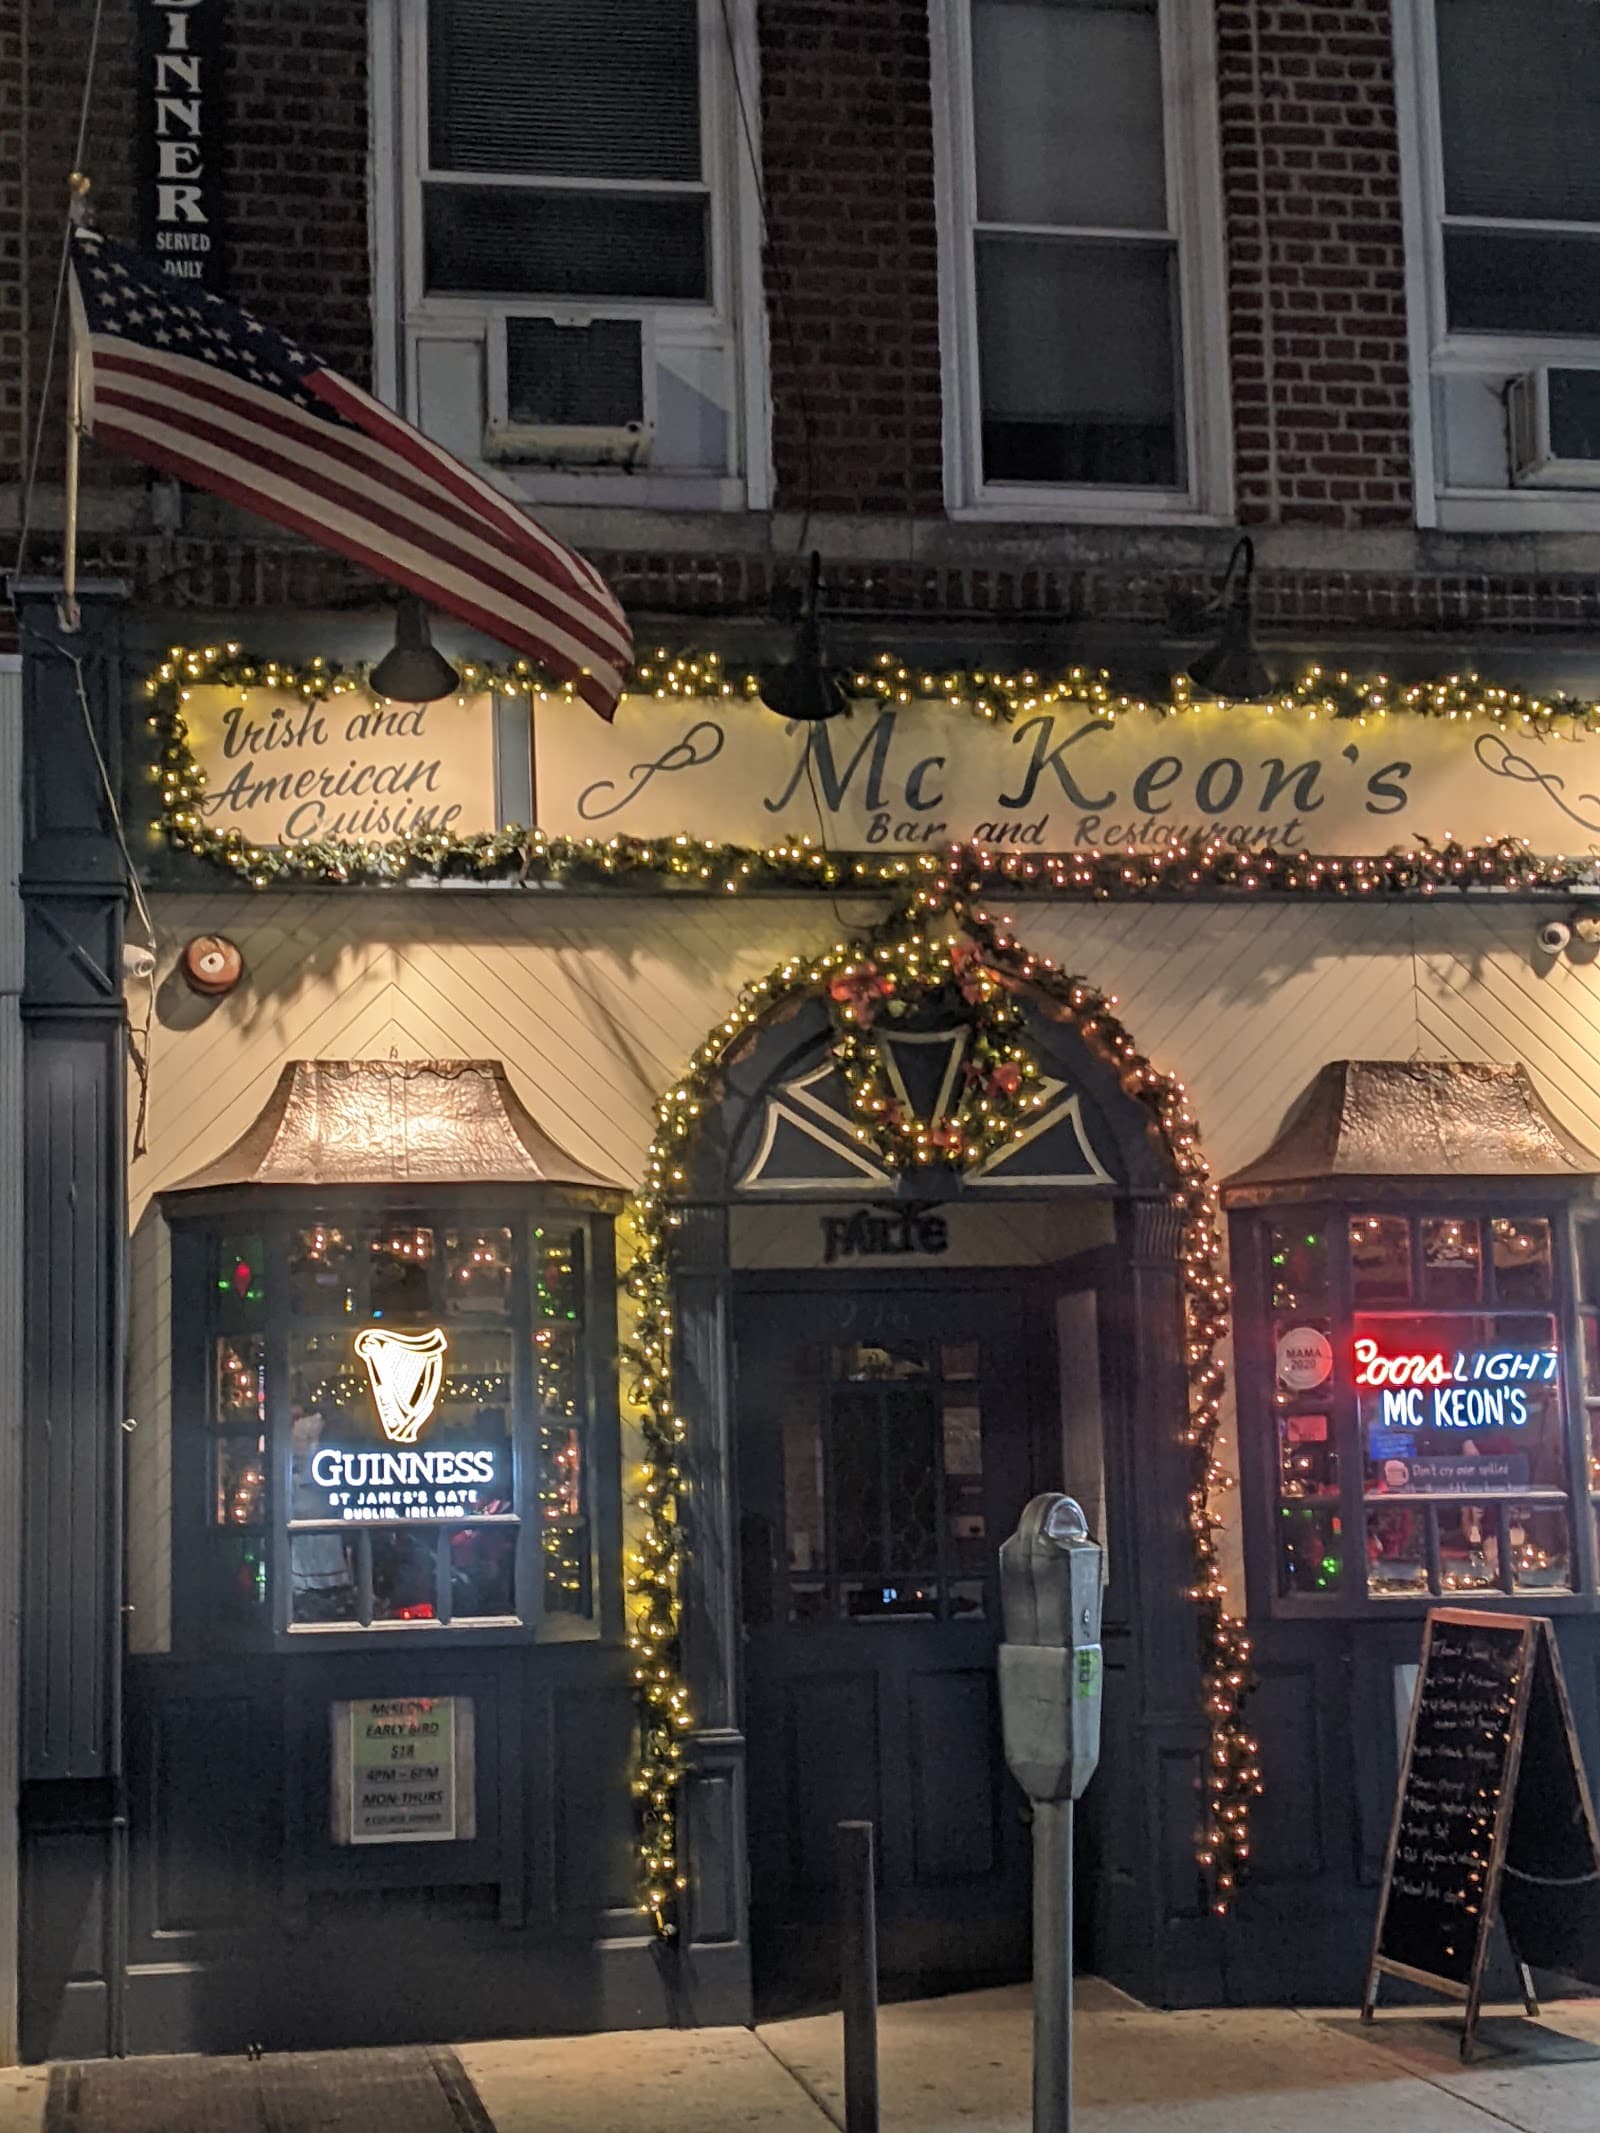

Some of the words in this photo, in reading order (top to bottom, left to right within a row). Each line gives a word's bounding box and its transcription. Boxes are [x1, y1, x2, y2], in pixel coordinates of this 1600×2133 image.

[154, 0, 208, 222] INNER
[156, 231, 211, 251] SERVED
[163, 259, 204, 280] DAILY
[222, 700, 329, 759] Irish
[345, 703, 426, 741] and
[201, 759, 442, 817] American
[284, 797, 463, 841] Cuisine
[866, 813, 947, 844] Bar
[974, 814, 1050, 846] and
[1073, 815, 1306, 848] Restaurant
[1285, 1347, 1322, 1359] MAMA
[1354, 1338, 1453, 1386] Coors
[1453, 1352, 1558, 1381] LIGHT
[1383, 1387, 1424, 1427] MC
[1433, 1386, 1528, 1428] KEON'S
[311, 1448, 495, 1487] GUINNESS
[356, 1490, 428, 1505] JAMES'S
[434, 1489, 478, 1504] GATE
[366, 1723, 405, 1738] EARLY
[408, 1722, 440, 1736] BIRD
